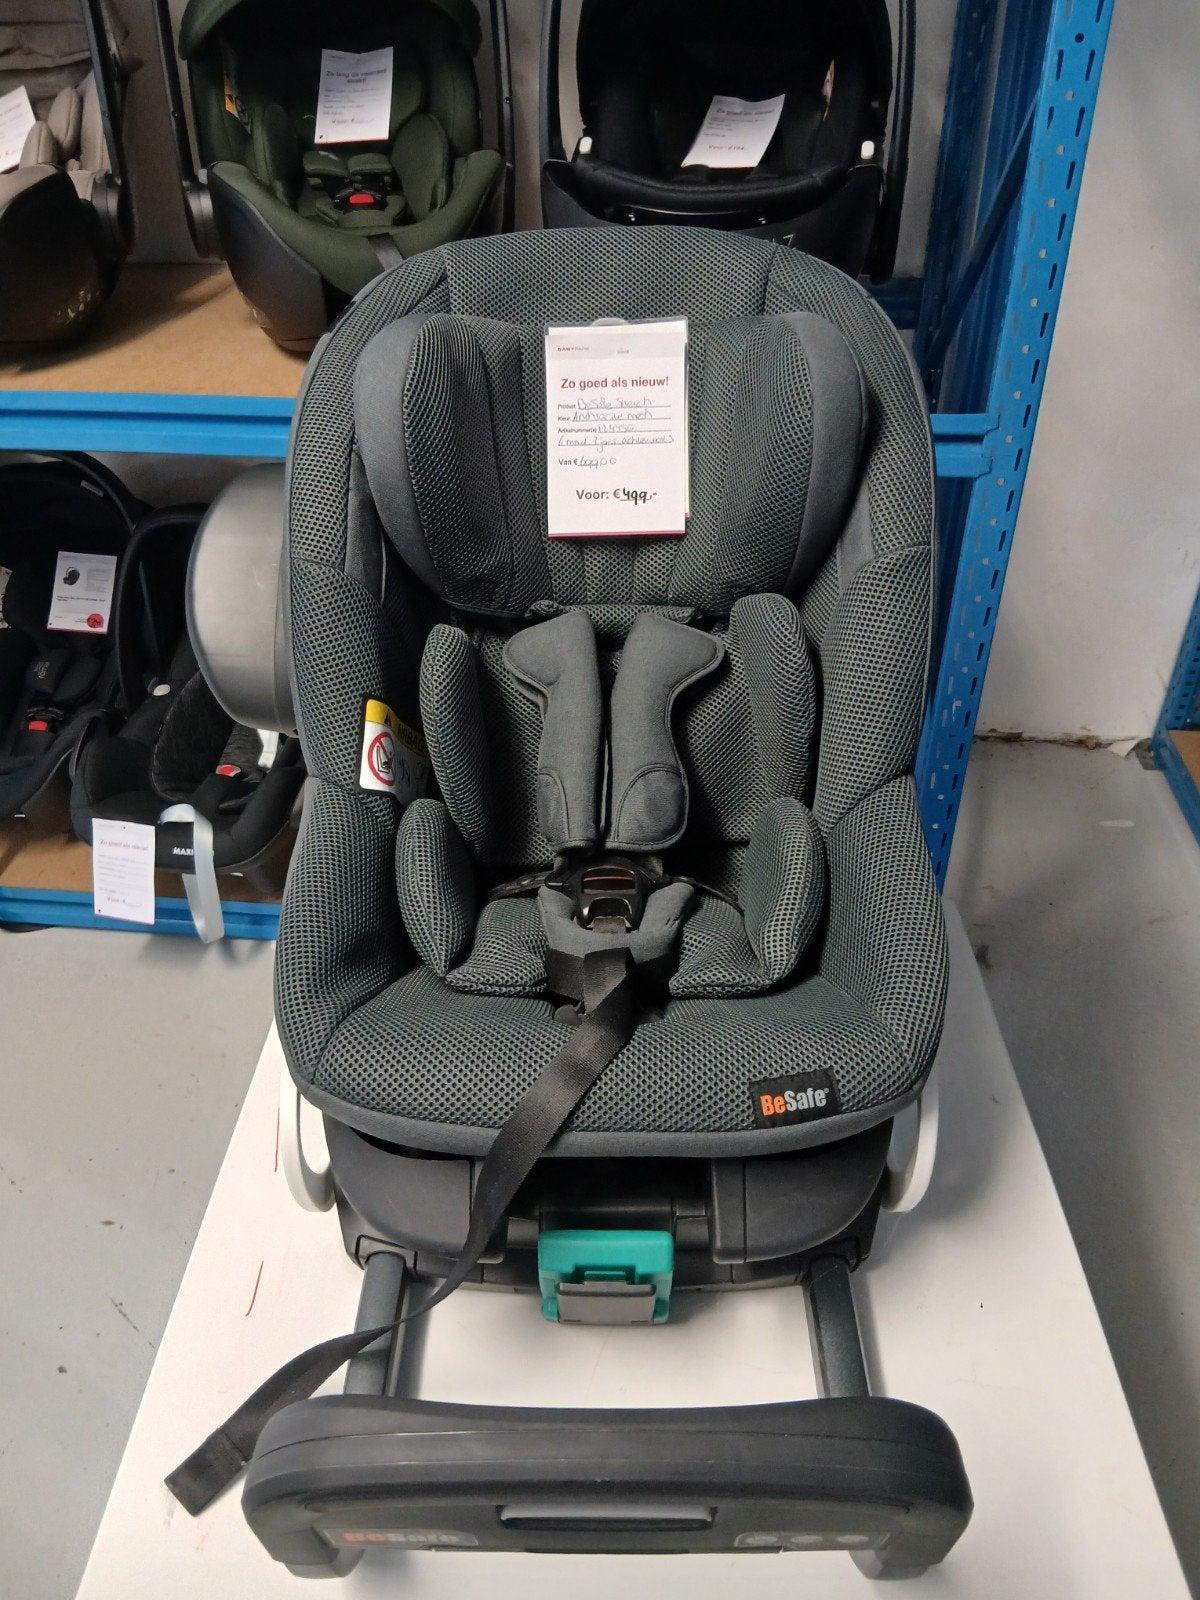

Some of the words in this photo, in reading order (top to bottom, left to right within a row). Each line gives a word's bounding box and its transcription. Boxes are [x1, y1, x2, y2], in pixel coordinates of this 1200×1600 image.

[560, 378, 576, 389] Zo
[579, 377, 608, 391] goed
[611, 376, 628, 388] als
[631, 376, 670, 388] nieuw!
[558, 458, 572, 466] Van
[576, 489, 610, 500] Voor:
